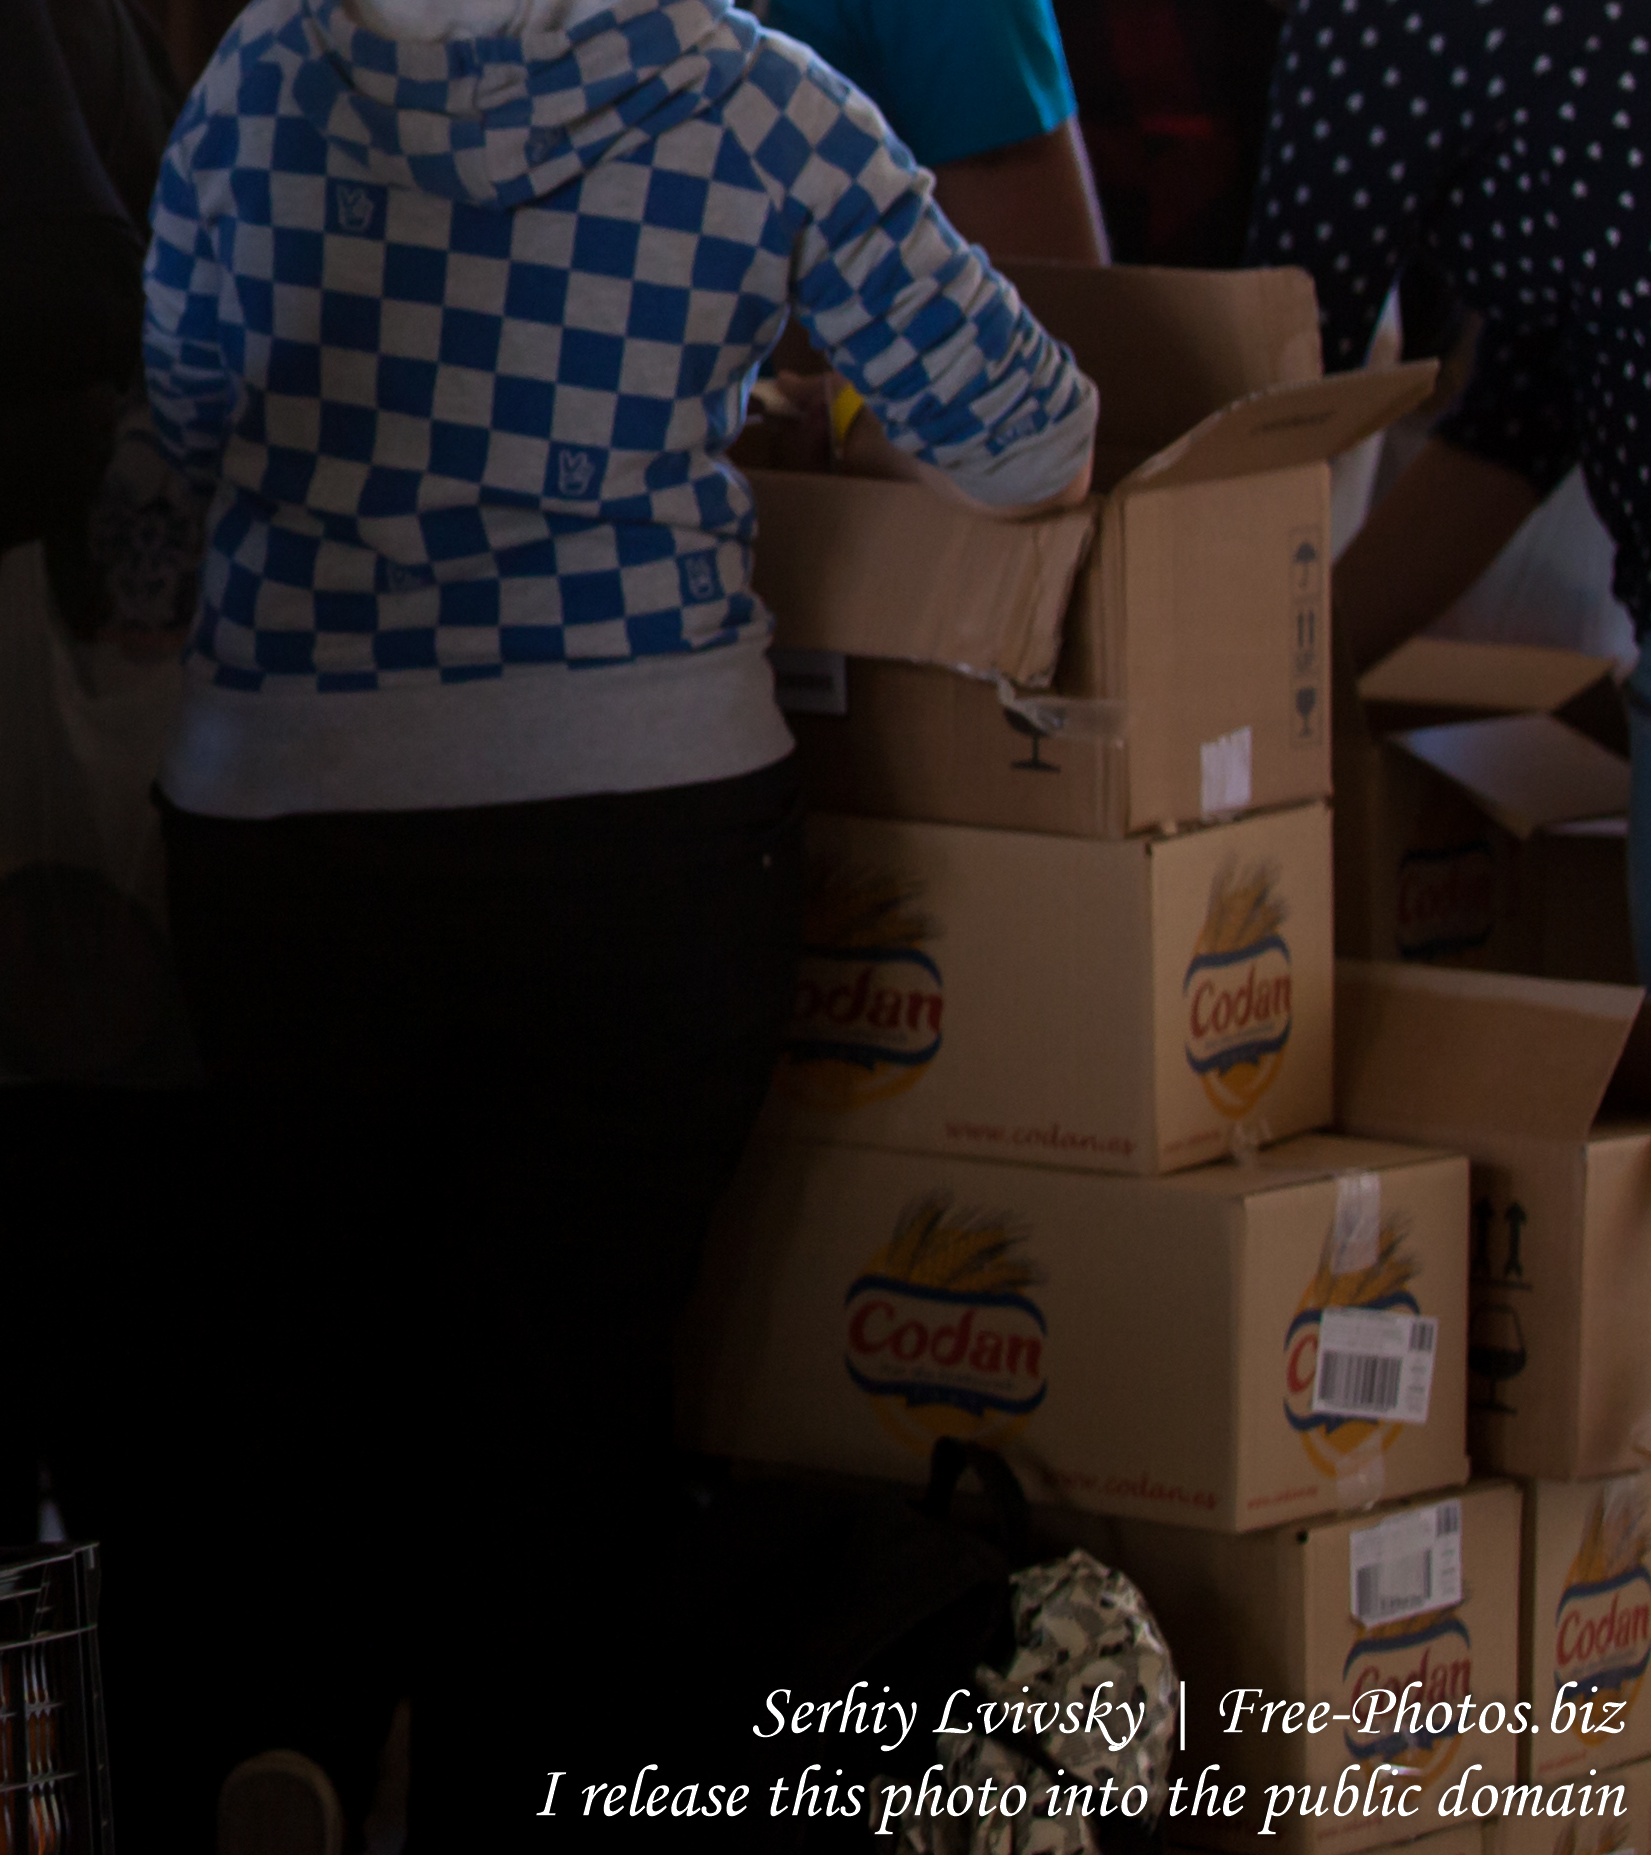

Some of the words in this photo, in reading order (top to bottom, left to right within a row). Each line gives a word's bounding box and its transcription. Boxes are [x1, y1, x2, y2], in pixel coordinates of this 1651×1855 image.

[794, 966, 943, 1034] odan
[1190, 964, 1292, 1039] Codan
[849, 1300, 1042, 1378] Codan
[1556, 1593, 1649, 1667] Codan
